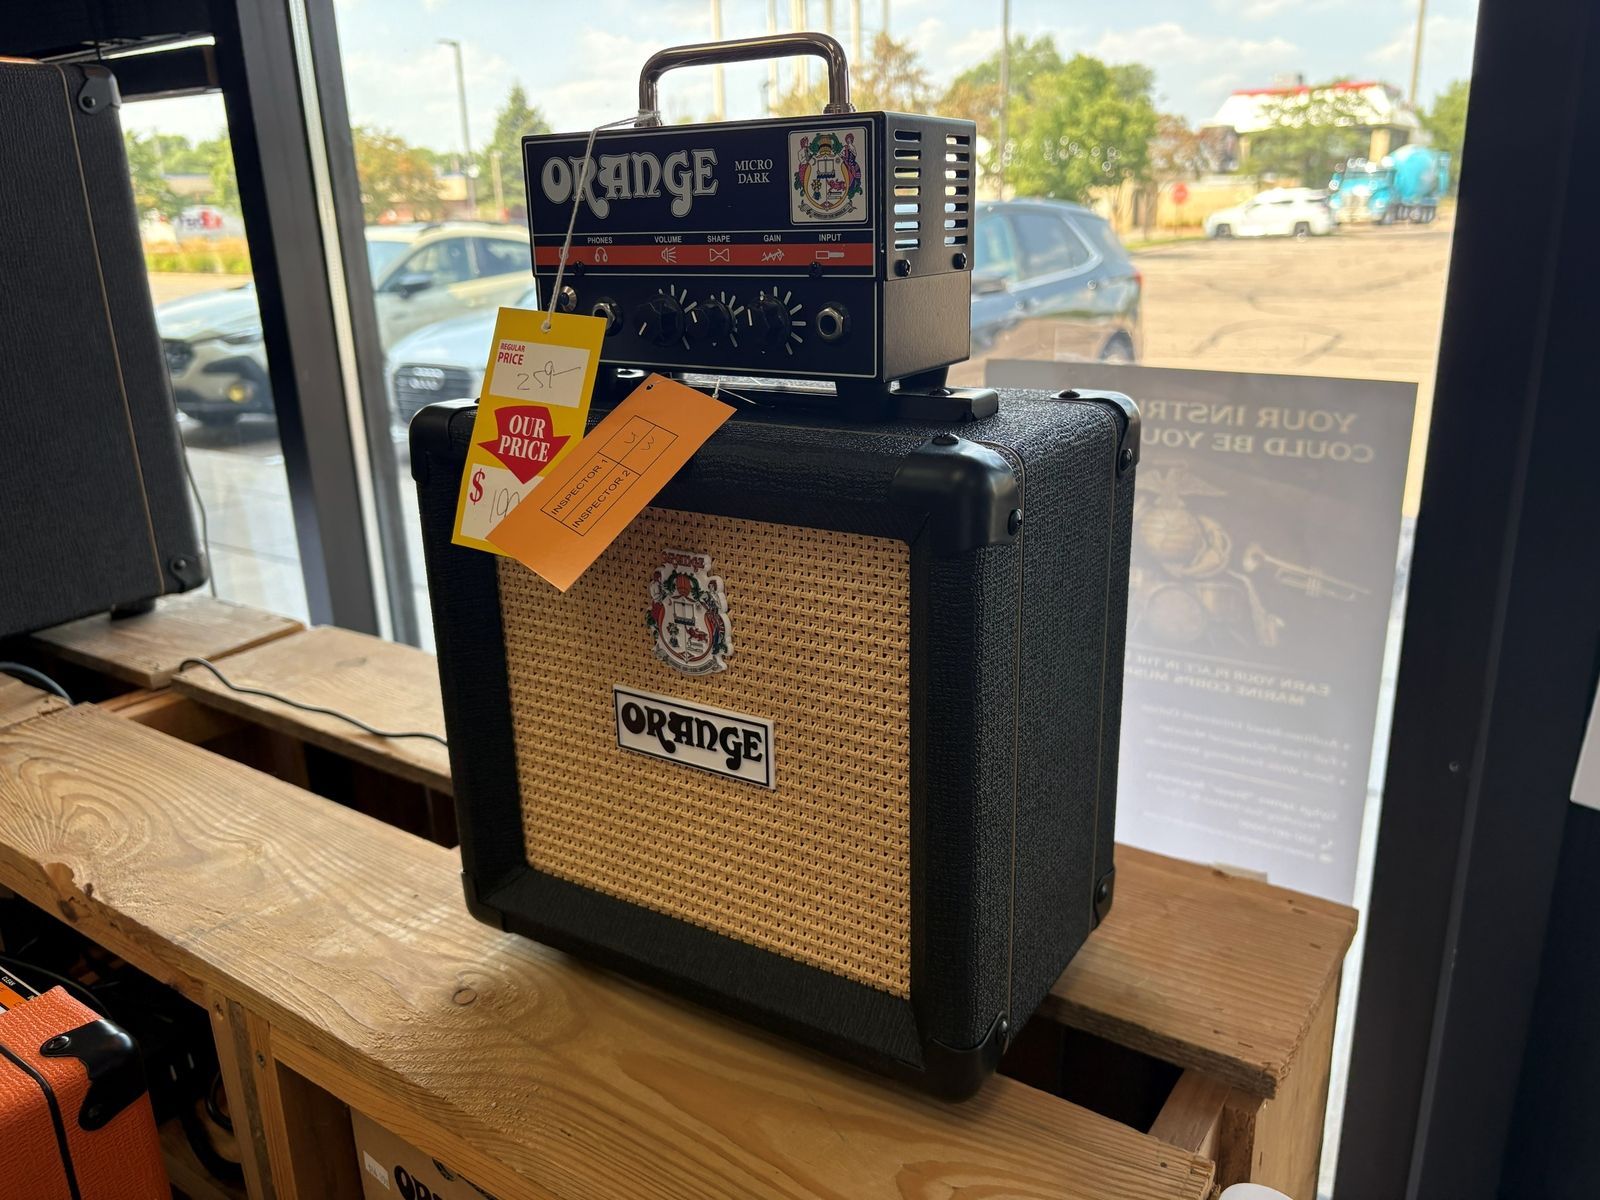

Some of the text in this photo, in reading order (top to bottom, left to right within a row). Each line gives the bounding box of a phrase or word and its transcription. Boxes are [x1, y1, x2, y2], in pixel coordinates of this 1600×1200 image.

[735, 159, 773, 171] MICRO
[541, 149, 719, 219] ORANGE
[738, 173, 770, 184] DARK
[707, 235, 730, 243] SHAPE
[764, 234, 781, 242] GAIN
[819, 233, 842, 241] INPUT
[498, 352, 524, 365] PRICE
[500, 343, 525, 352] REGULAR
[509, 414, 546, 438] OUR
[498, 435, 550, 462] PRICE
[470, 468, 485, 505] $
[551, 465, 602, 515] INSPECTOR
[571, 477, 624, 528] INSPECTOR
[621, 702, 762, 770] ORANGE
